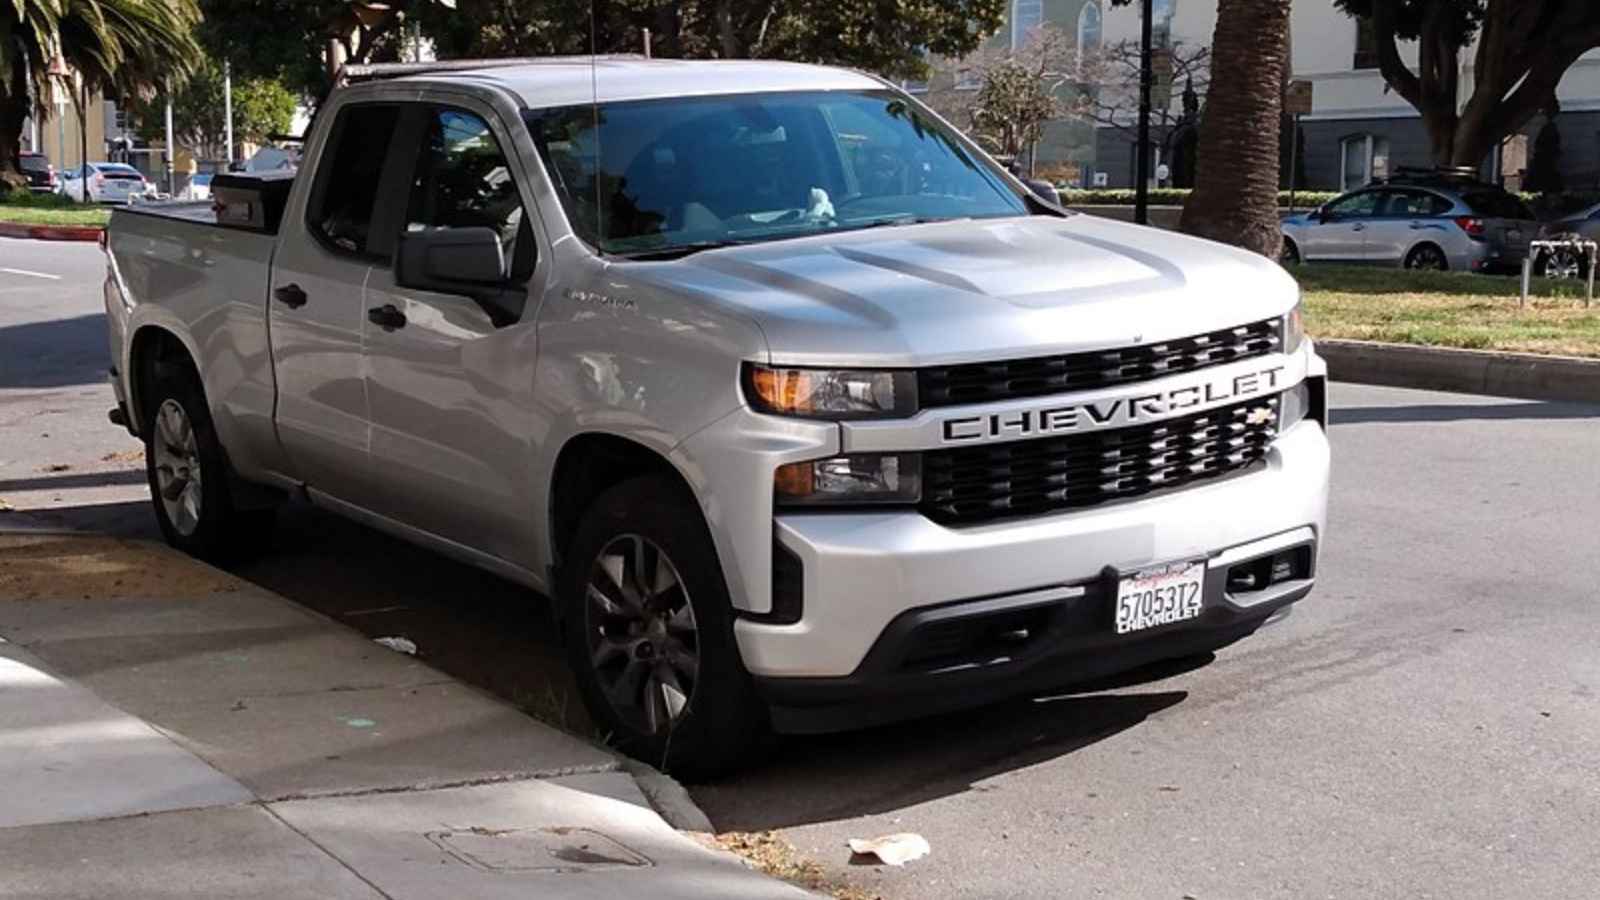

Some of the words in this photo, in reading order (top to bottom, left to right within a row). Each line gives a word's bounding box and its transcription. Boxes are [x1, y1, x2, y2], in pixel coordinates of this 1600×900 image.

[943, 366, 1284, 441] CHEVROLET
[1117, 606, 1199, 634] CHEVROLET
[1119, 580, 1200, 622] 57053T2
